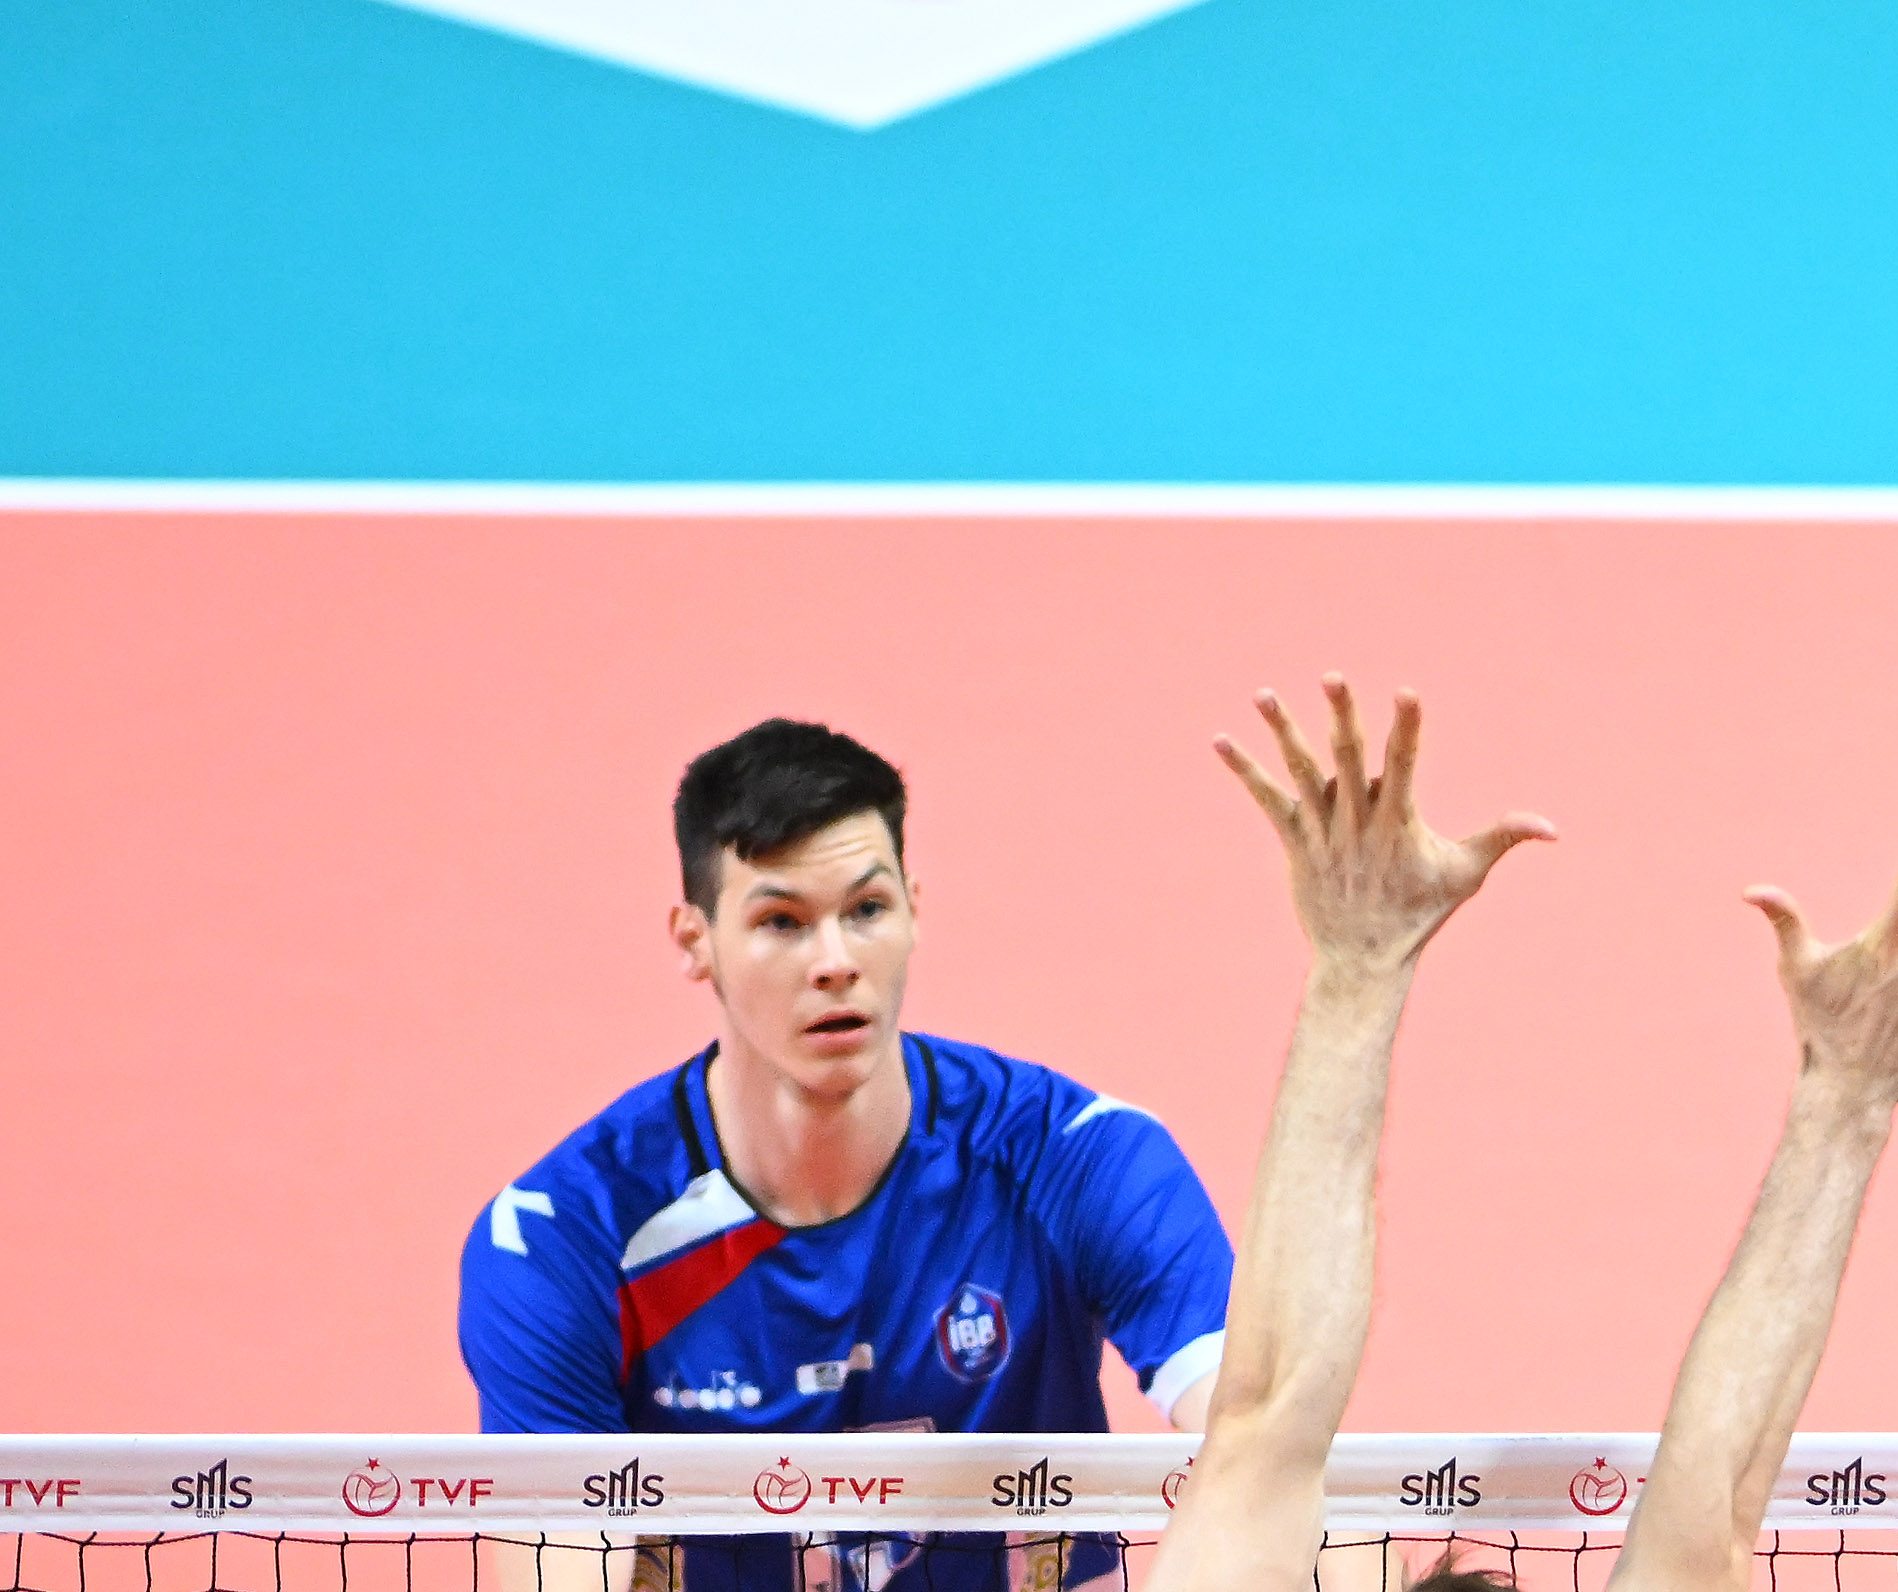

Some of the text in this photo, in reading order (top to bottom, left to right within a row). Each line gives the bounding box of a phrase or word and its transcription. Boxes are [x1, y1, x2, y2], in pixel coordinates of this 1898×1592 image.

[0, 1479, 81, 1508] TVF
[171, 1457, 253, 1509] SMS
[411, 1478, 494, 1507] TVF
[583, 1456, 665, 1508] SMS
[822, 1477, 904, 1505] TVF
[991, 1456, 1073, 1508] SMS
[1400, 1456, 1482, 1508] SMS
[1806, 1456, 1887, 1507] SMS
